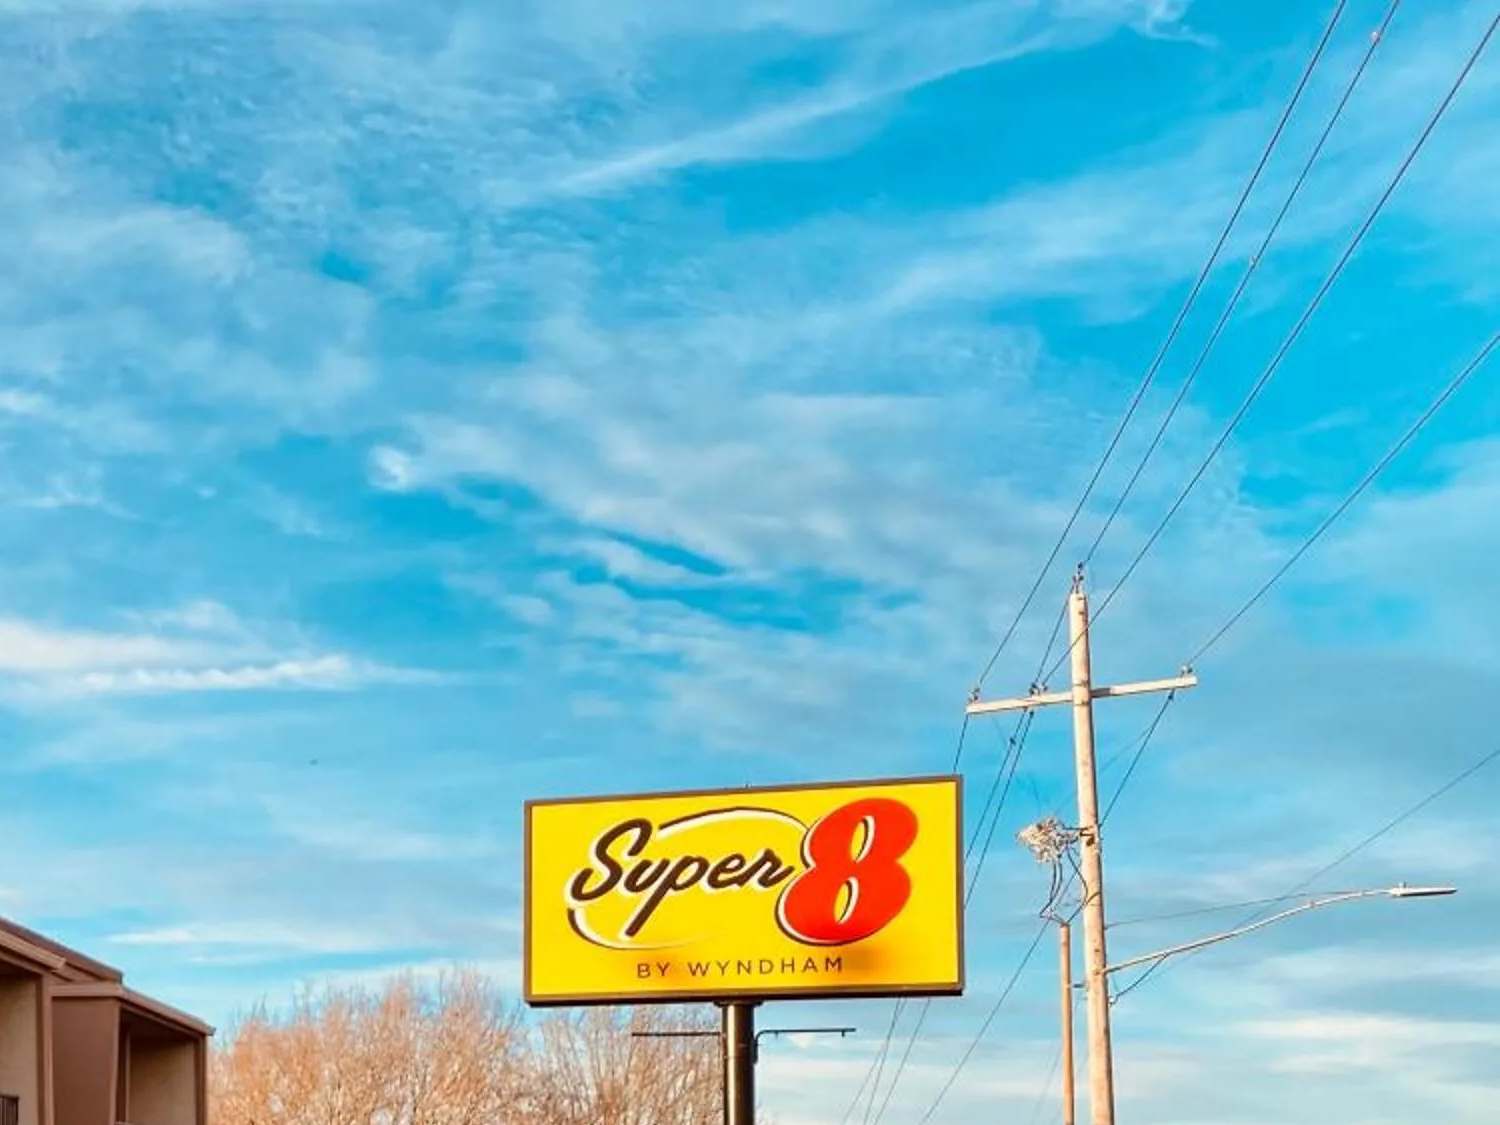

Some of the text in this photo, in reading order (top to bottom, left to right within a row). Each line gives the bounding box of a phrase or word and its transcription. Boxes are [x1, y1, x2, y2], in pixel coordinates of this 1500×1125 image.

[570, 798, 919, 946] Super 8
[637, 956, 843, 979] BY WYNDHAM
